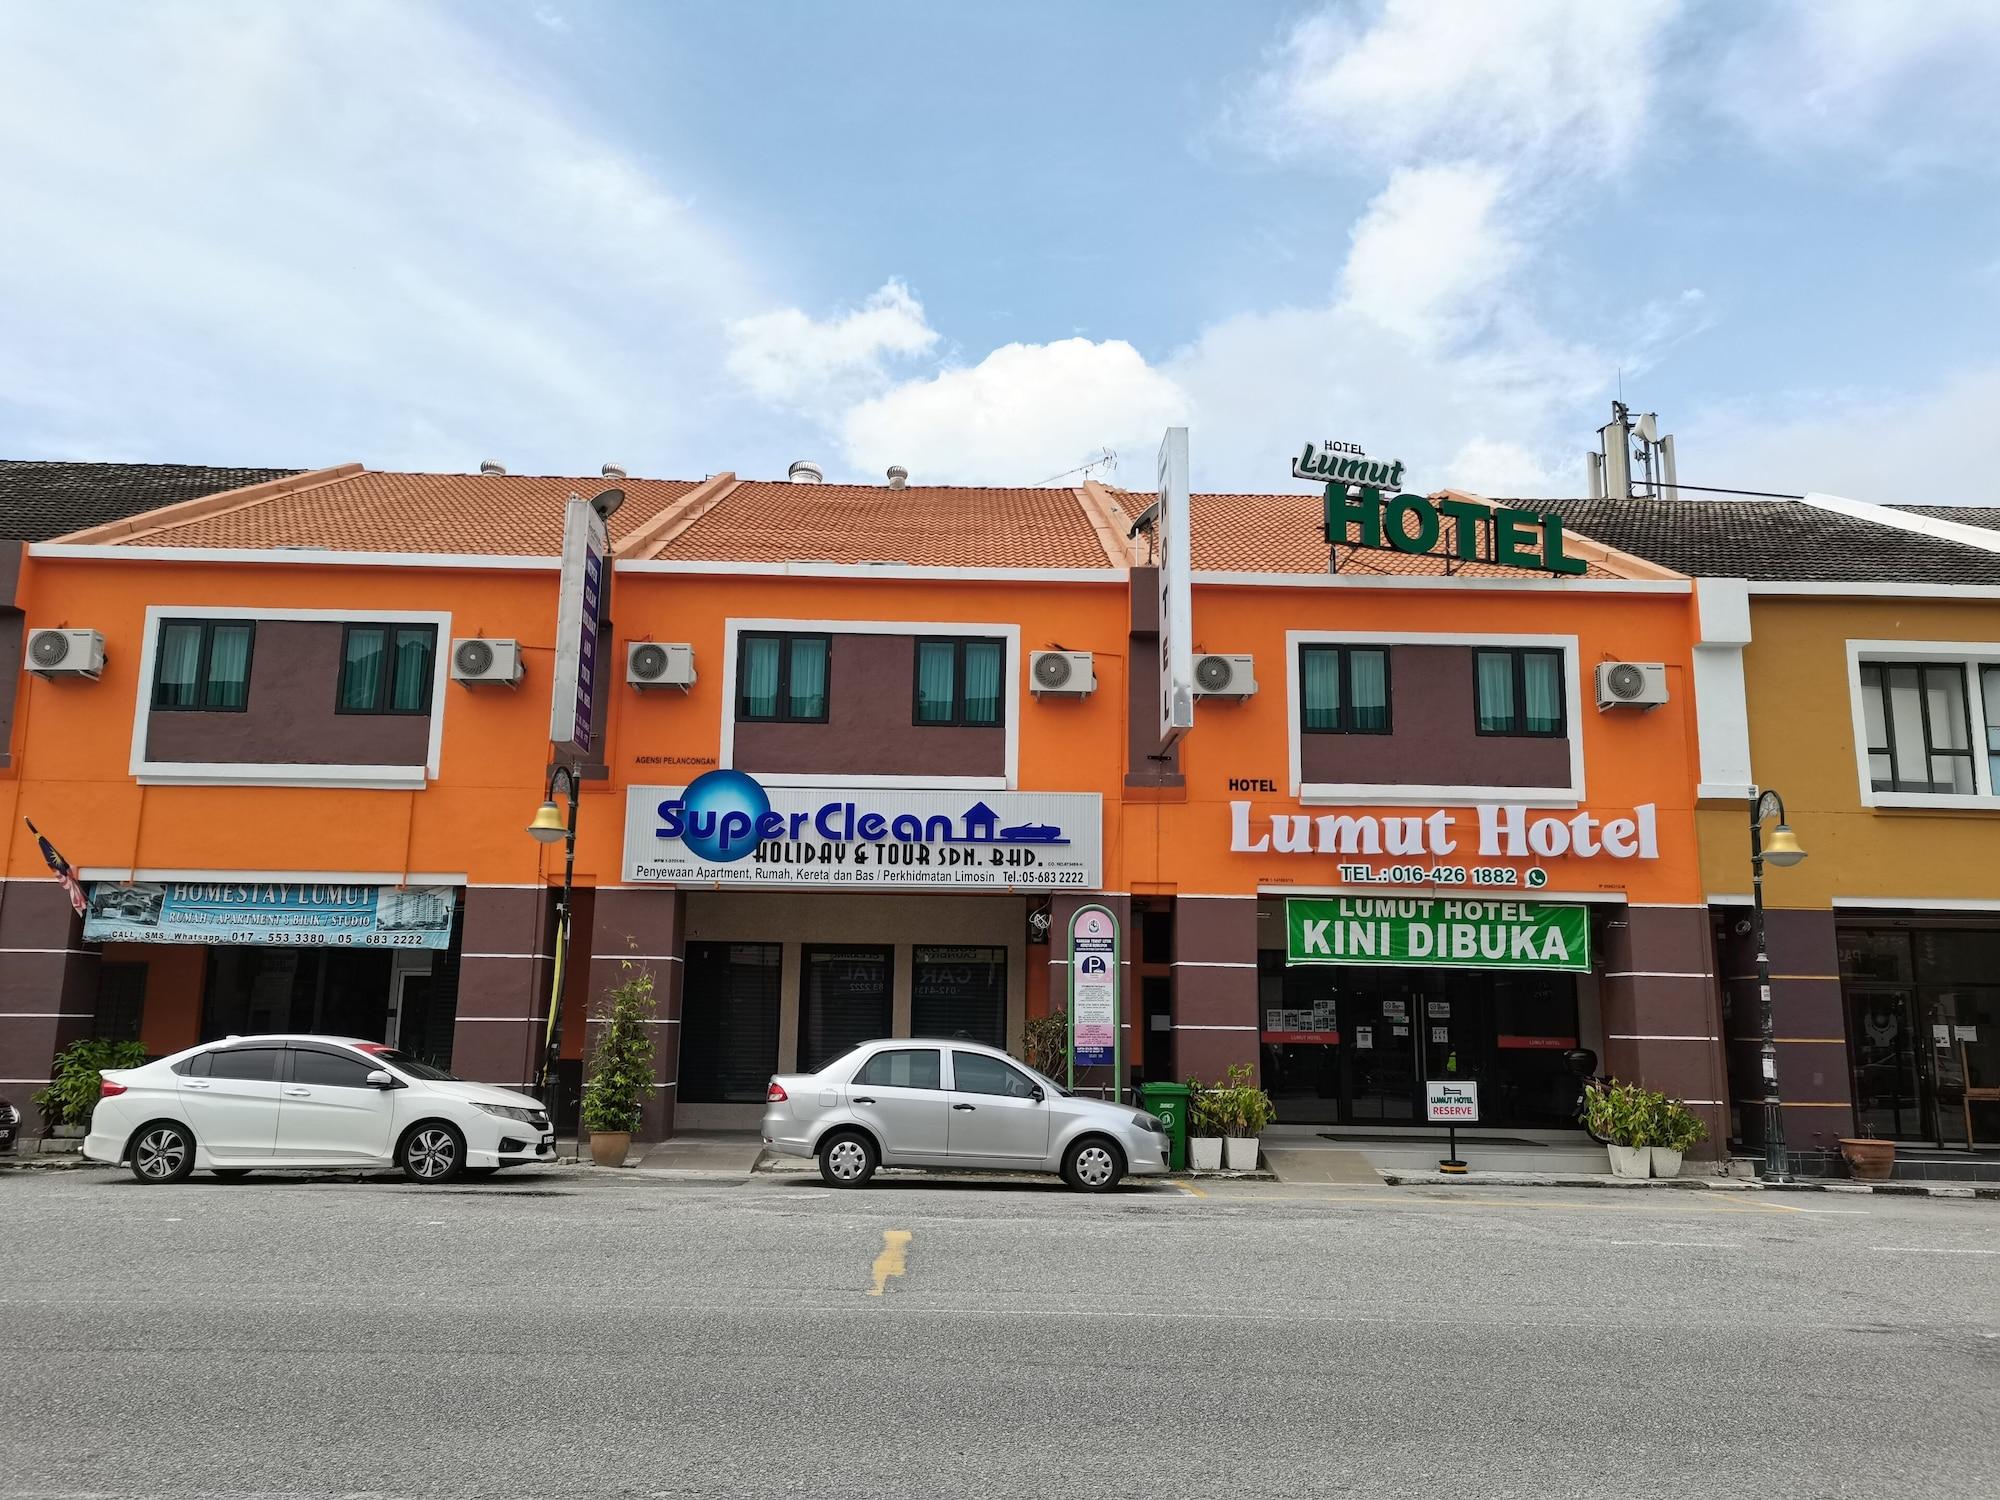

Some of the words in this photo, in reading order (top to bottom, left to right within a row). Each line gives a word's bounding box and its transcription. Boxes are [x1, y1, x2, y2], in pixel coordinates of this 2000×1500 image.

[1324, 440, 1365, 455] HOTEL
[1300, 444, 1404, 486] Lumut
[1326, 482, 1587, 575] HOTEL
[1161, 484, 1169, 722] HOTEL
[663, 757, 716, 766] PELANCONGAN
[1229, 779, 1277, 792] HOTEL
[1230, 800, 1457, 856] Lumut
[1476, 803, 1659, 858] Hotel
[752, 841, 846, 865] HOLIDAY
[854, 842, 869, 865] &
[875, 843, 930, 866] TOUR
[938, 847, 983, 867] SDN.
[988, 848, 1043, 867] BHD.
[636, 865, 694, 879] Penyewaan
[696, 866, 752, 880] Apartment,
[755, 867, 793, 881] Rumah,
[796, 868, 829, 881] Kereta
[833, 870, 852, 881] dan
[855, 870, 874, 881] Bas
[883, 870, 952, 882] Perkhidmatan
[955, 871, 995, 882] Limosin
[1059, 872, 1084, 883] 2222
[1473, 868, 1516, 884] 1882
[173, 884, 292, 904] HOMESTAY
[298, 884, 372, 906] LUMUT
[168, 912, 206, 924] RUMAH
[216, 912, 281, 926] APARTMENT
[284, 914, 290, 926] 3
[292, 914, 320, 926] BILIK
[331, 915, 370, 927] STUDIO
[1340, 899, 1434, 919] LUMUT
[1444, 901, 1535, 922] HOTEL
[111, 931, 134, 939] CALL
[145, 932, 165, 940] SMS
[174, 932, 220, 943] Whatsapp
[231, 932, 254, 942] 017
[267, 933, 290, 943] 553
[295, 933, 325, 943] 3380
[338, 934, 352, 944] 05
[366, 935, 387, 945] 683
[393, 935, 423, 945] 2222
[1303, 919, 1391, 956] KINI
[1408, 922, 1570, 961] DIBUKA
[1089, 957, 1101, 974] P
[1433, 1106, 1472, 1115] RESERVE
